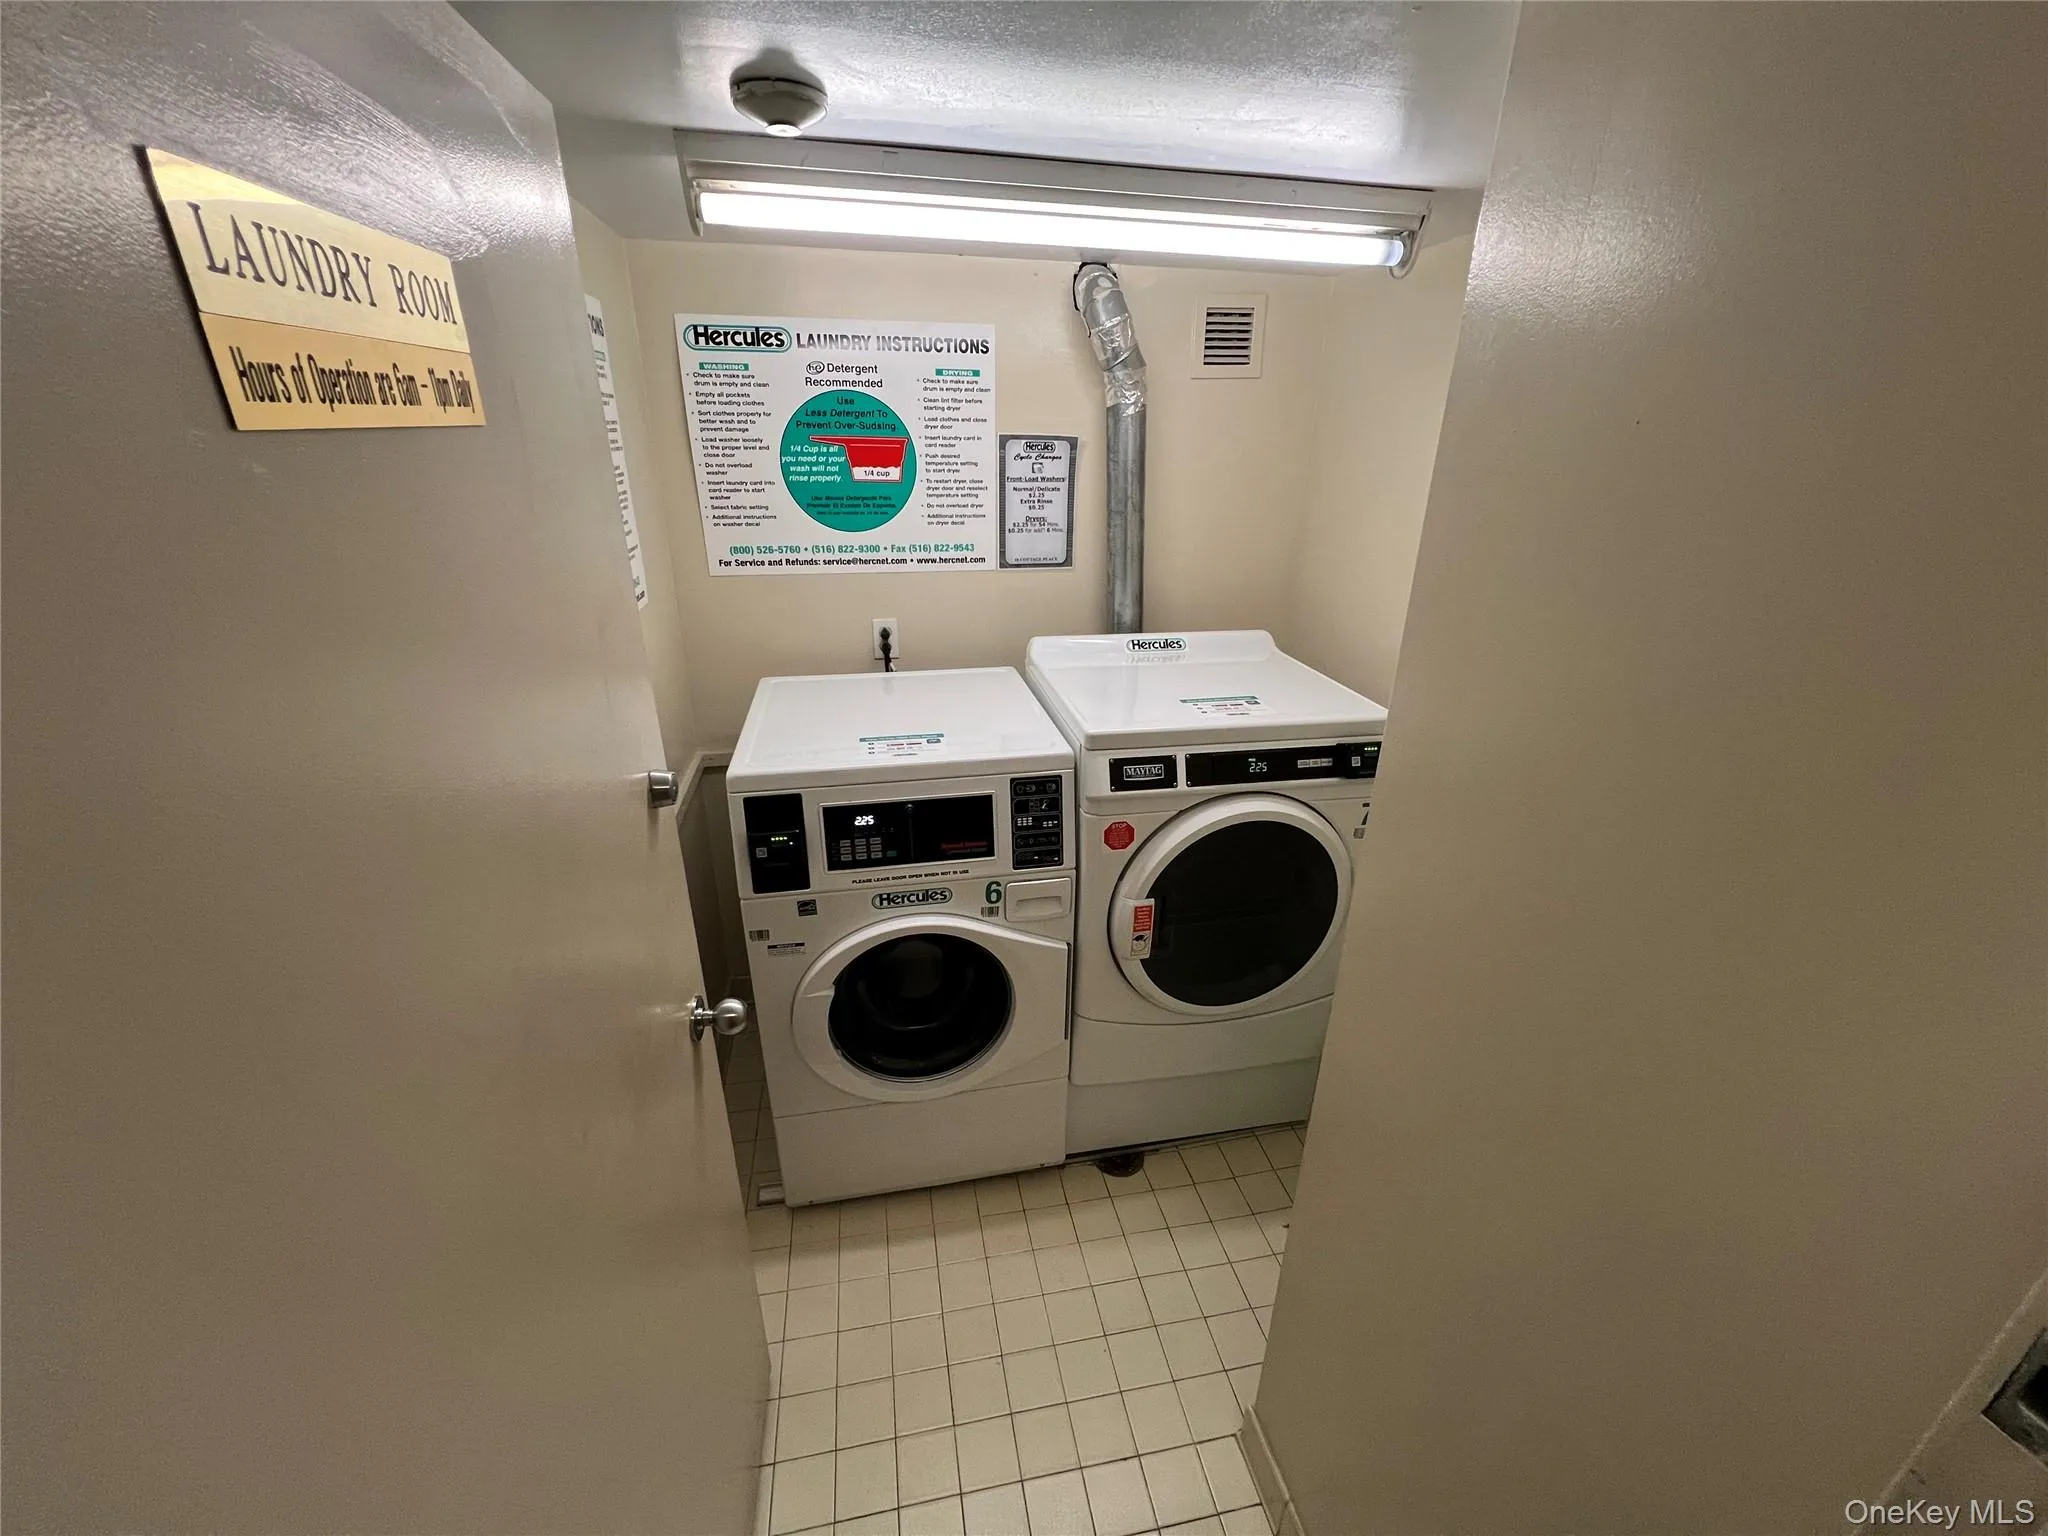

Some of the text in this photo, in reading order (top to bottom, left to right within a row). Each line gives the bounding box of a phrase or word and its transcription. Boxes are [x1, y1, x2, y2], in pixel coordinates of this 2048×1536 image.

[187, 201, 457, 325] LAUNDRY ROOM
[692, 324, 785, 348] Hercules
[796, 333, 990, 354] LAUNDRY INSTRUCTIONS
[827, 363, 878, 376] Detergent
[229, 346, 292, 403] Hours
[291, 352, 311, 402] of
[307, 354, 376, 412] Operation
[374, 371, 396, 404] are
[392, 363, 422, 406] 6am
[448, 370, 476, 413] Daily
[805, 377, 883, 389] Recommended
[837, 396, 855, 405] Use
[805, 409, 888, 420] Less Detergent To
[796, 420, 896, 432] Prevent Over-Sudsing
[790, 444, 801, 453] 1/4
[803, 445, 819, 454] Cup
[820, 445, 827, 453] is
[1025, 441, 1054, 451] Hercules
[781, 456, 796, 464] you
[798, 455, 816, 463] need
[828, 456, 846, 464] your
[876, 470, 890, 478] cup
[729, 544, 975, 556] (800) 526-5760 (516) 822-9300 Fax (516) 822-9543
[719, 556, 986, 567] For Service and Refunds: service@hercnet.com www.hercnet.com
[1132, 637, 1184, 651] Hercules
[1126, 766, 1162, 776] MAYTAG
[879, 888, 948, 906] Hercules
[985, 880, 1002, 905] 6
